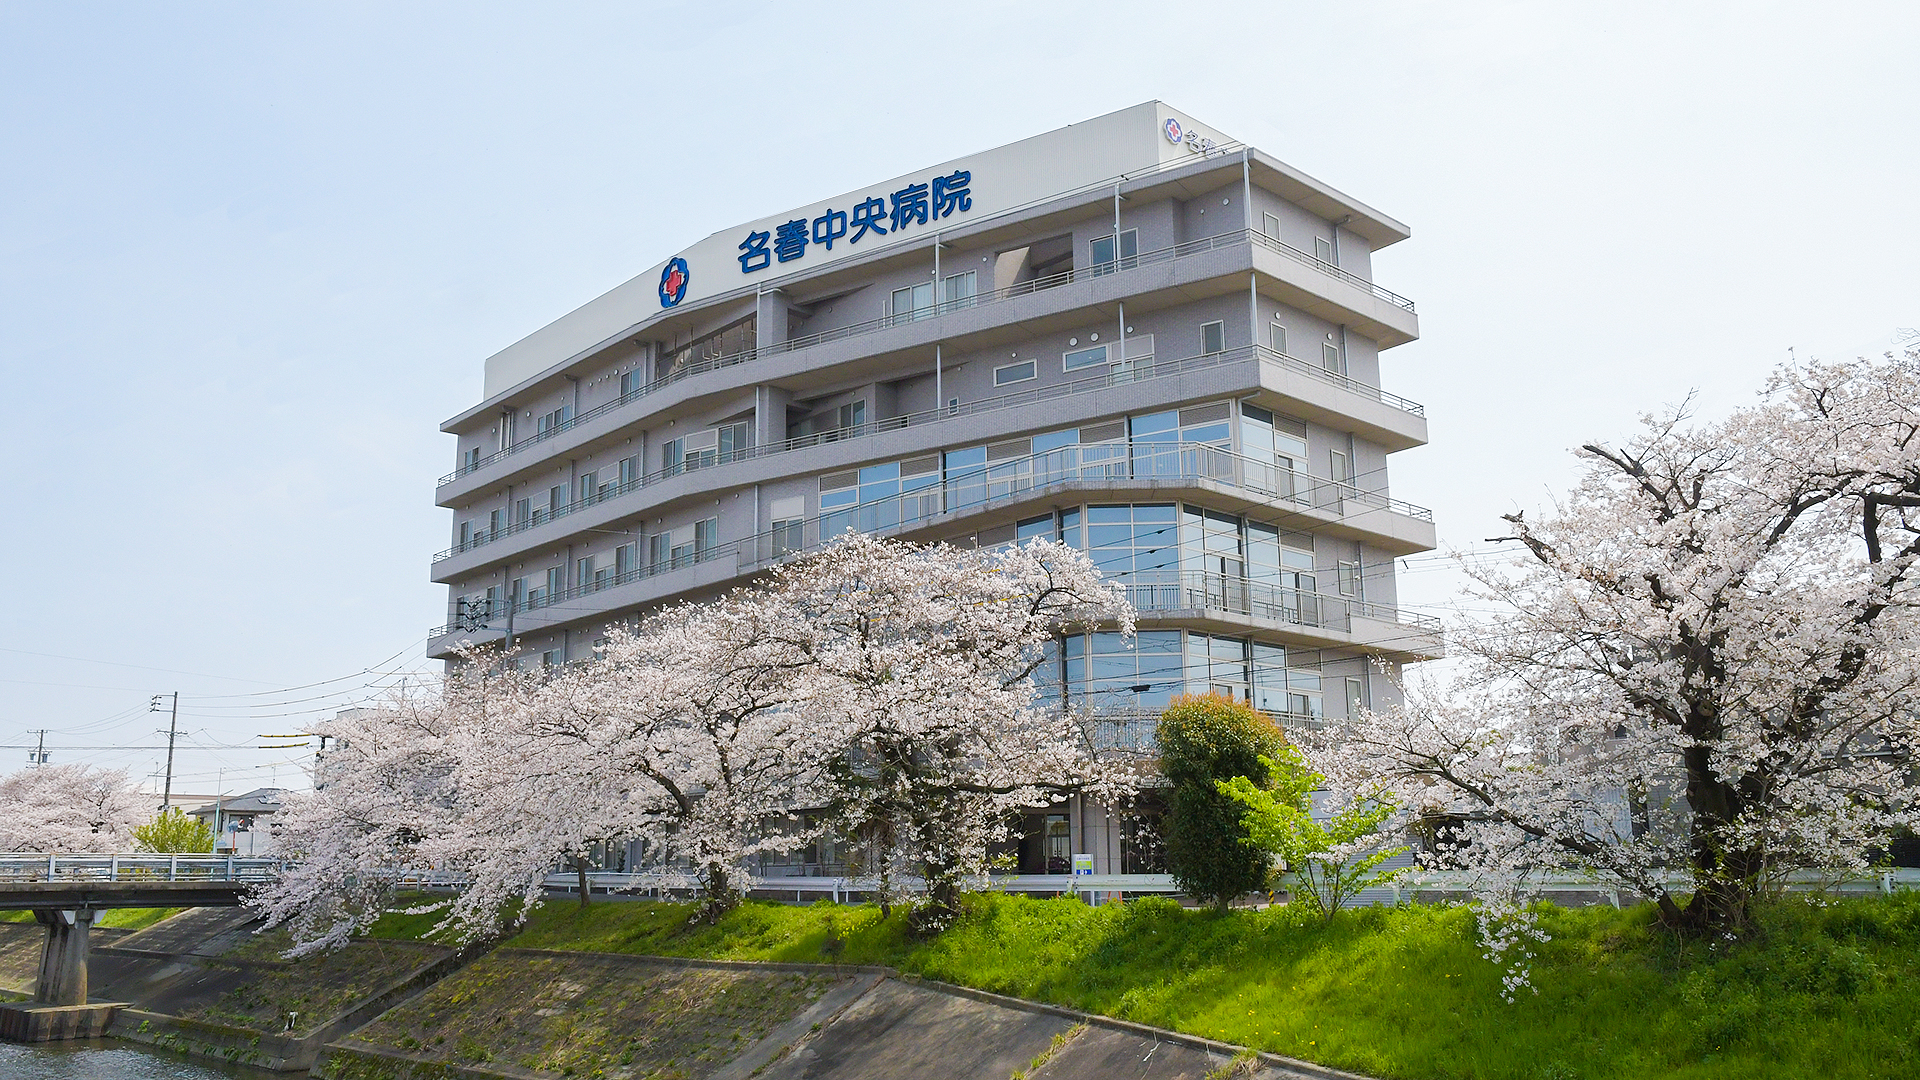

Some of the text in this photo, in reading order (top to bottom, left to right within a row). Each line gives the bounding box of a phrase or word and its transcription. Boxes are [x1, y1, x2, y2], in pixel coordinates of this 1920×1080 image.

[737, 170, 973, 274] 名春中央病院
